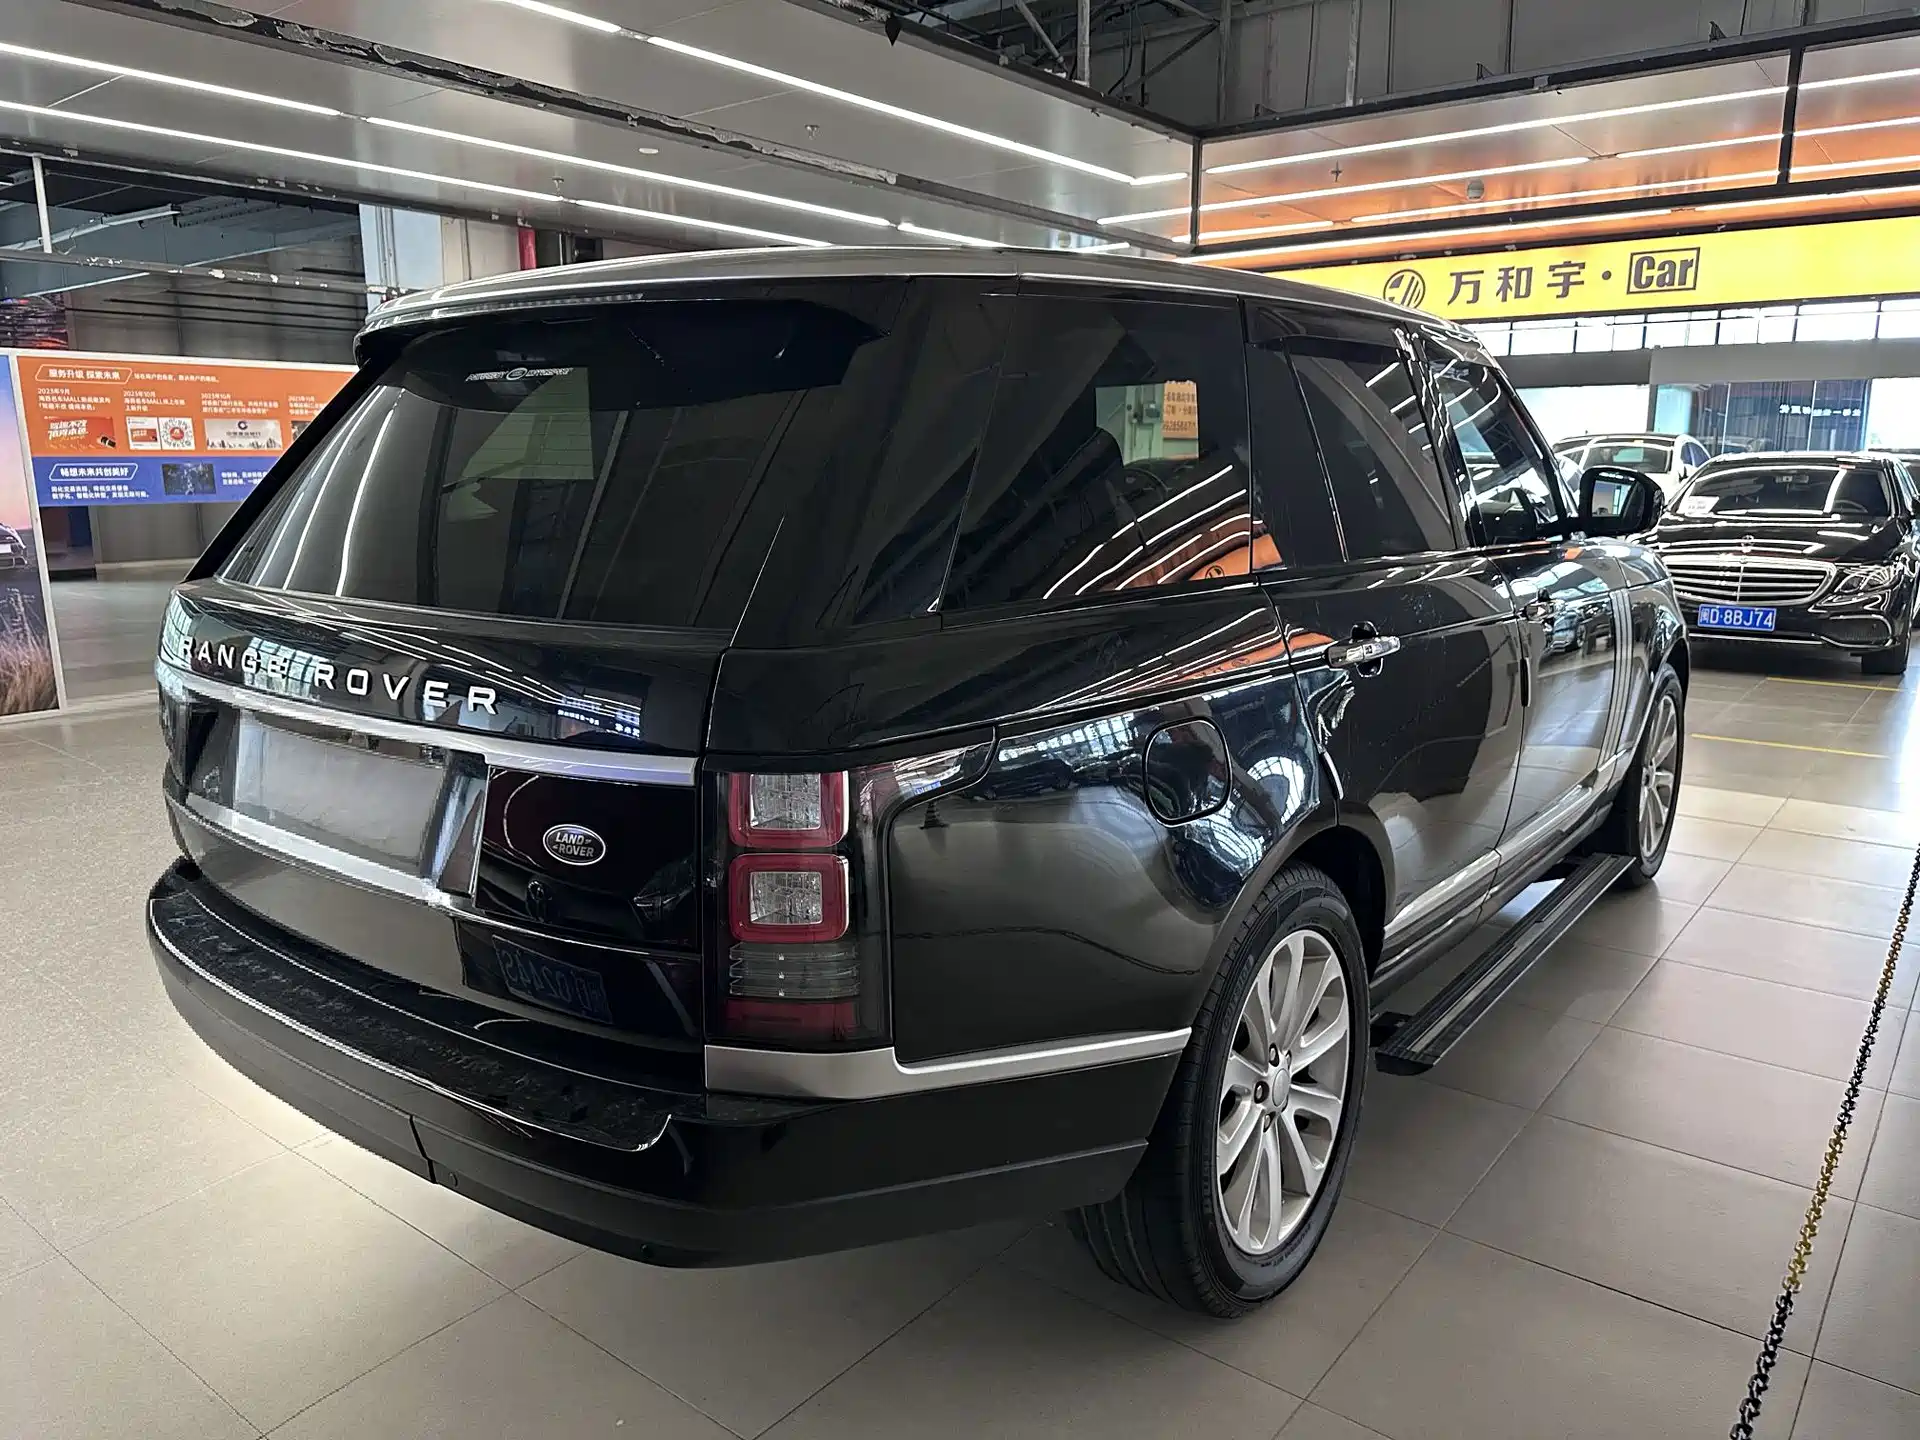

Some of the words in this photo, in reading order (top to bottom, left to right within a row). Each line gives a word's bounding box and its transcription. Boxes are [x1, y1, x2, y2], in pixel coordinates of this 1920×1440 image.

[1633, 255, 1694, 290] Car
[181, 635, 290, 678] RANGE
[313, 660, 498, 716] ROVER
[555, 831, 585, 846] LAND
[557, 843, 595, 858] ROVER
